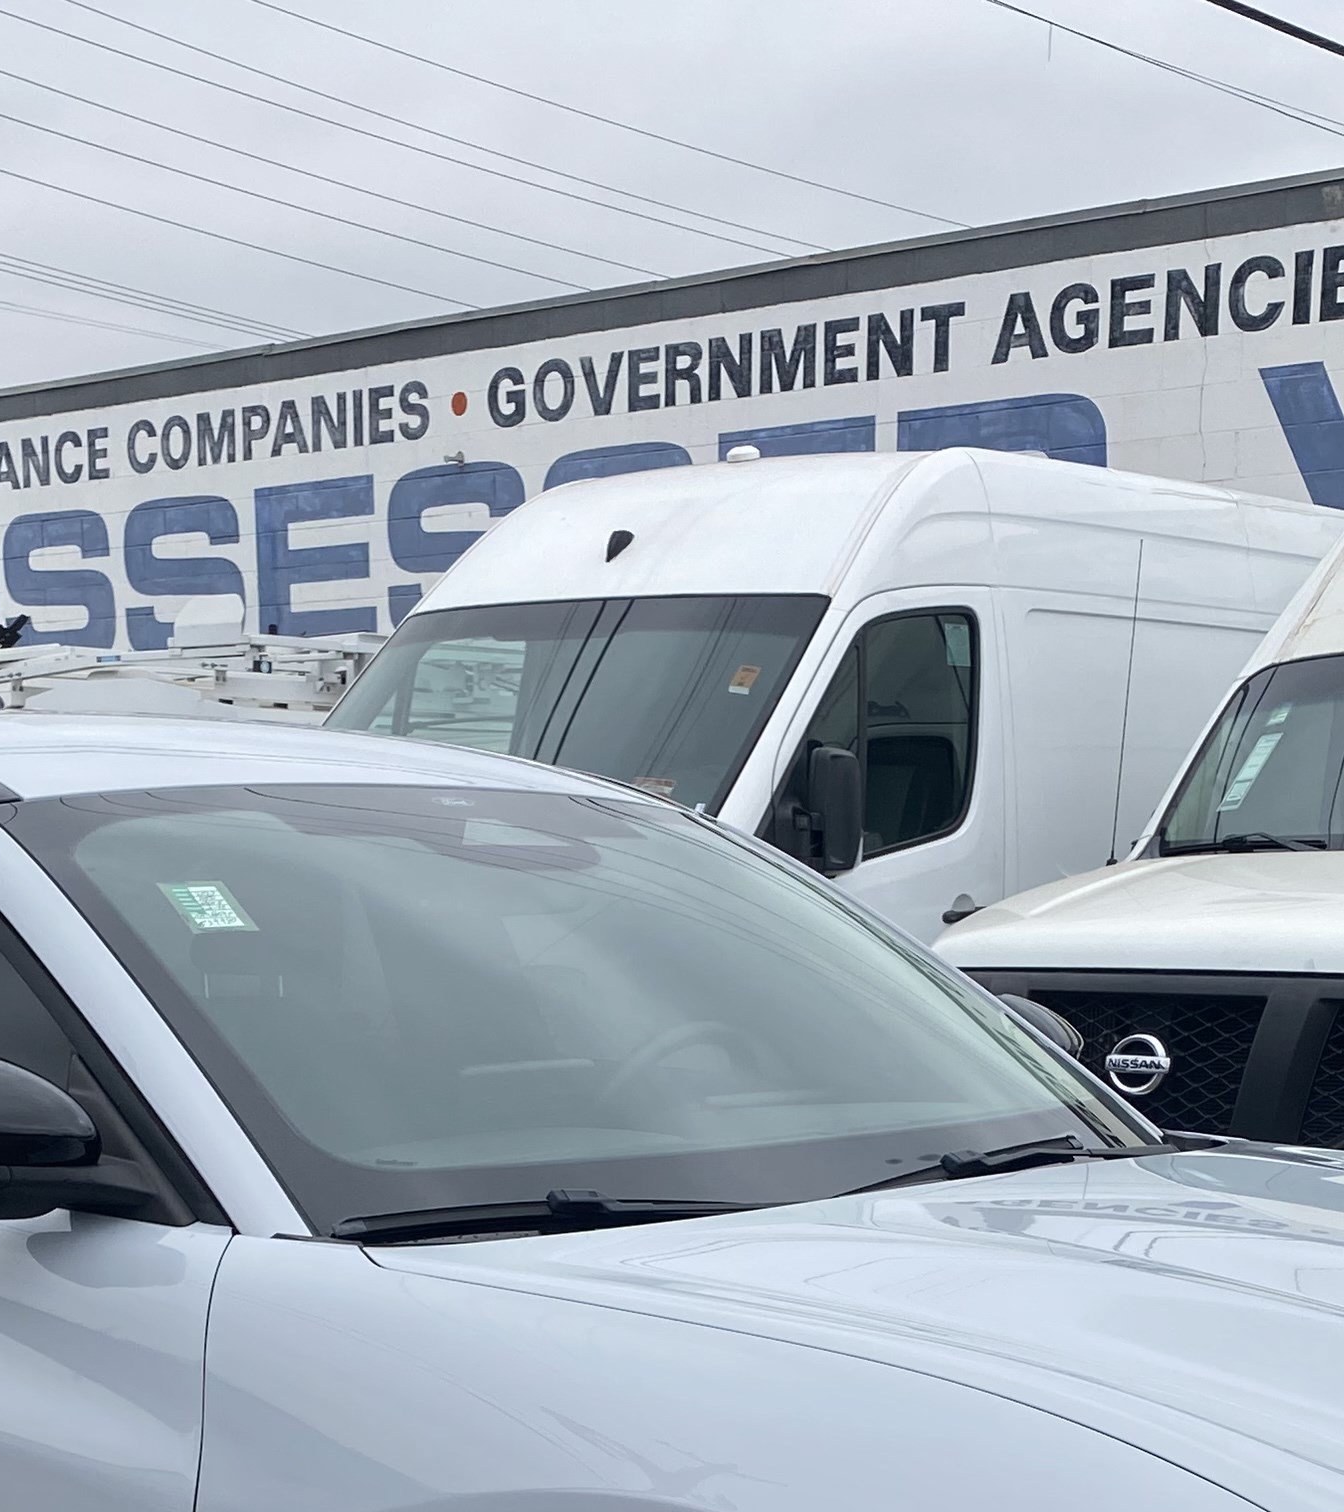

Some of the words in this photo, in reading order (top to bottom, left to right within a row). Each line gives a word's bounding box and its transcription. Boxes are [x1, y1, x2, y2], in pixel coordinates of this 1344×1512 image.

[127, 380, 431, 475] COMPANIES
[486, 300, 967, 429] GOVERNMENT
[1108, 1058, 1159, 1070] NISSAN
